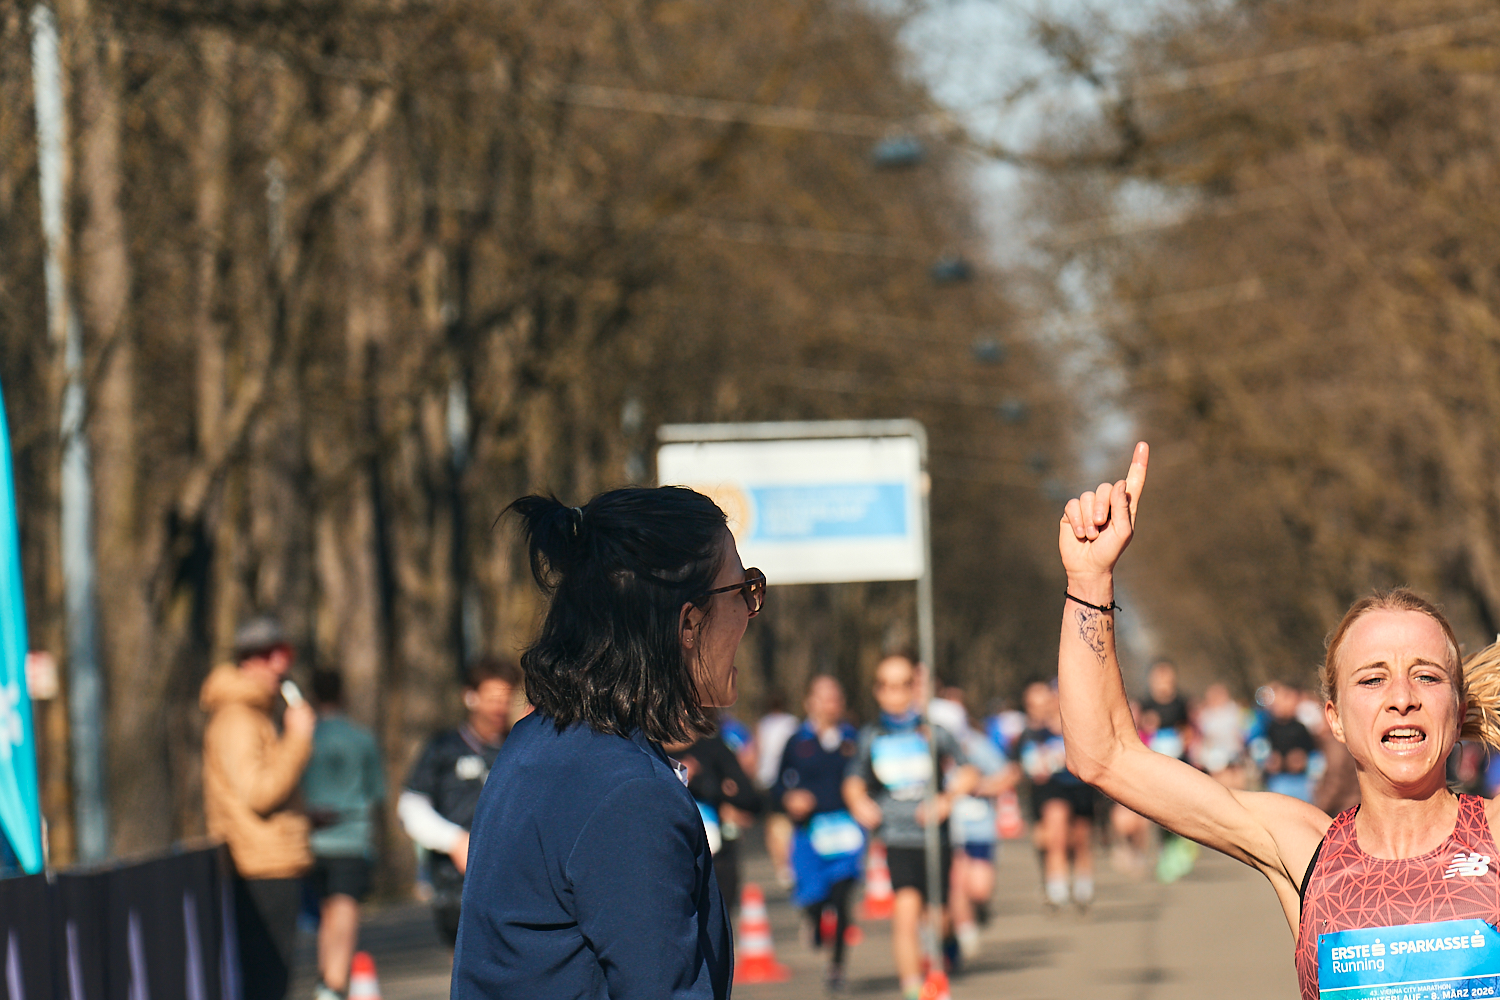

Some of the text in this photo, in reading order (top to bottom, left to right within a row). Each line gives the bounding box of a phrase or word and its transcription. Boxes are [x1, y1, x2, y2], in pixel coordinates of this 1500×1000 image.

[1331, 936, 1470, 961] ERSTE SPARKASSE
[1332, 957, 1385, 974] Running
[1380, 987, 1403, 996] VIENNA
[1403, 986, 1417, 994] CITY
[1417, 983, 1452, 993] MARATHON
[1431, 992, 1440, 1000] 8.
[1442, 988, 1469, 999] MÄRZ
[1471, 986, 1494, 996] 2026
